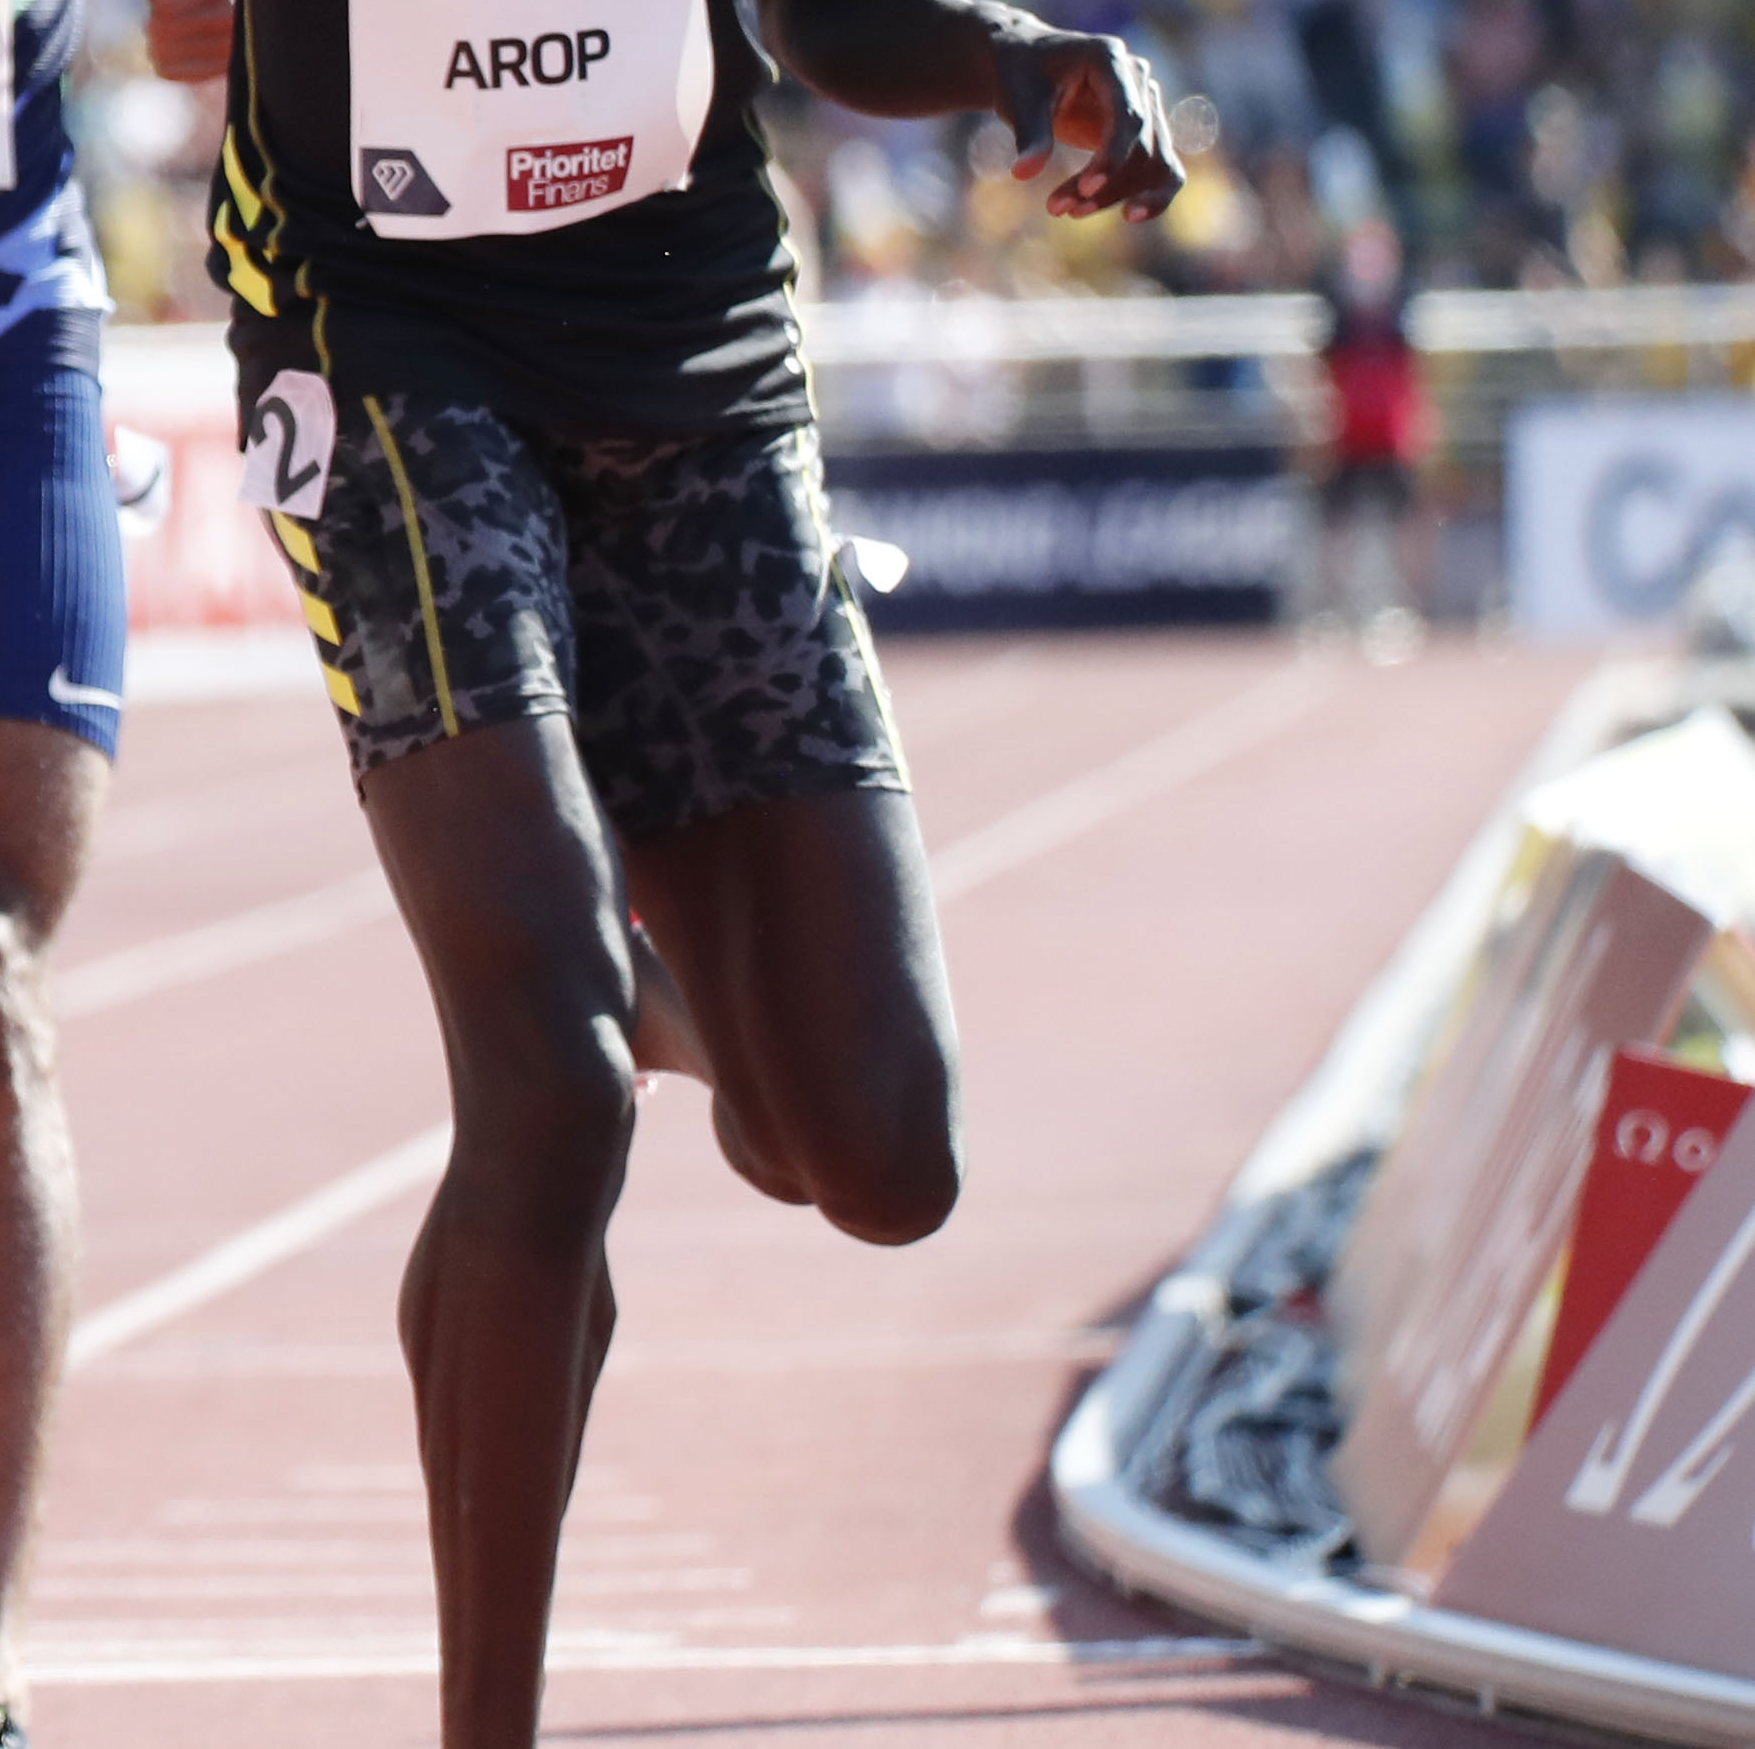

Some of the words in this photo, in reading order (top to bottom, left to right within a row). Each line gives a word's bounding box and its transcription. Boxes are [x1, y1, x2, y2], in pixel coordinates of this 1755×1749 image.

[444, 28, 611, 91] AROP
[509, 141, 628, 181] Prioritet
[526, 176, 609, 209] Finans
[249, 395, 322, 504] 2
